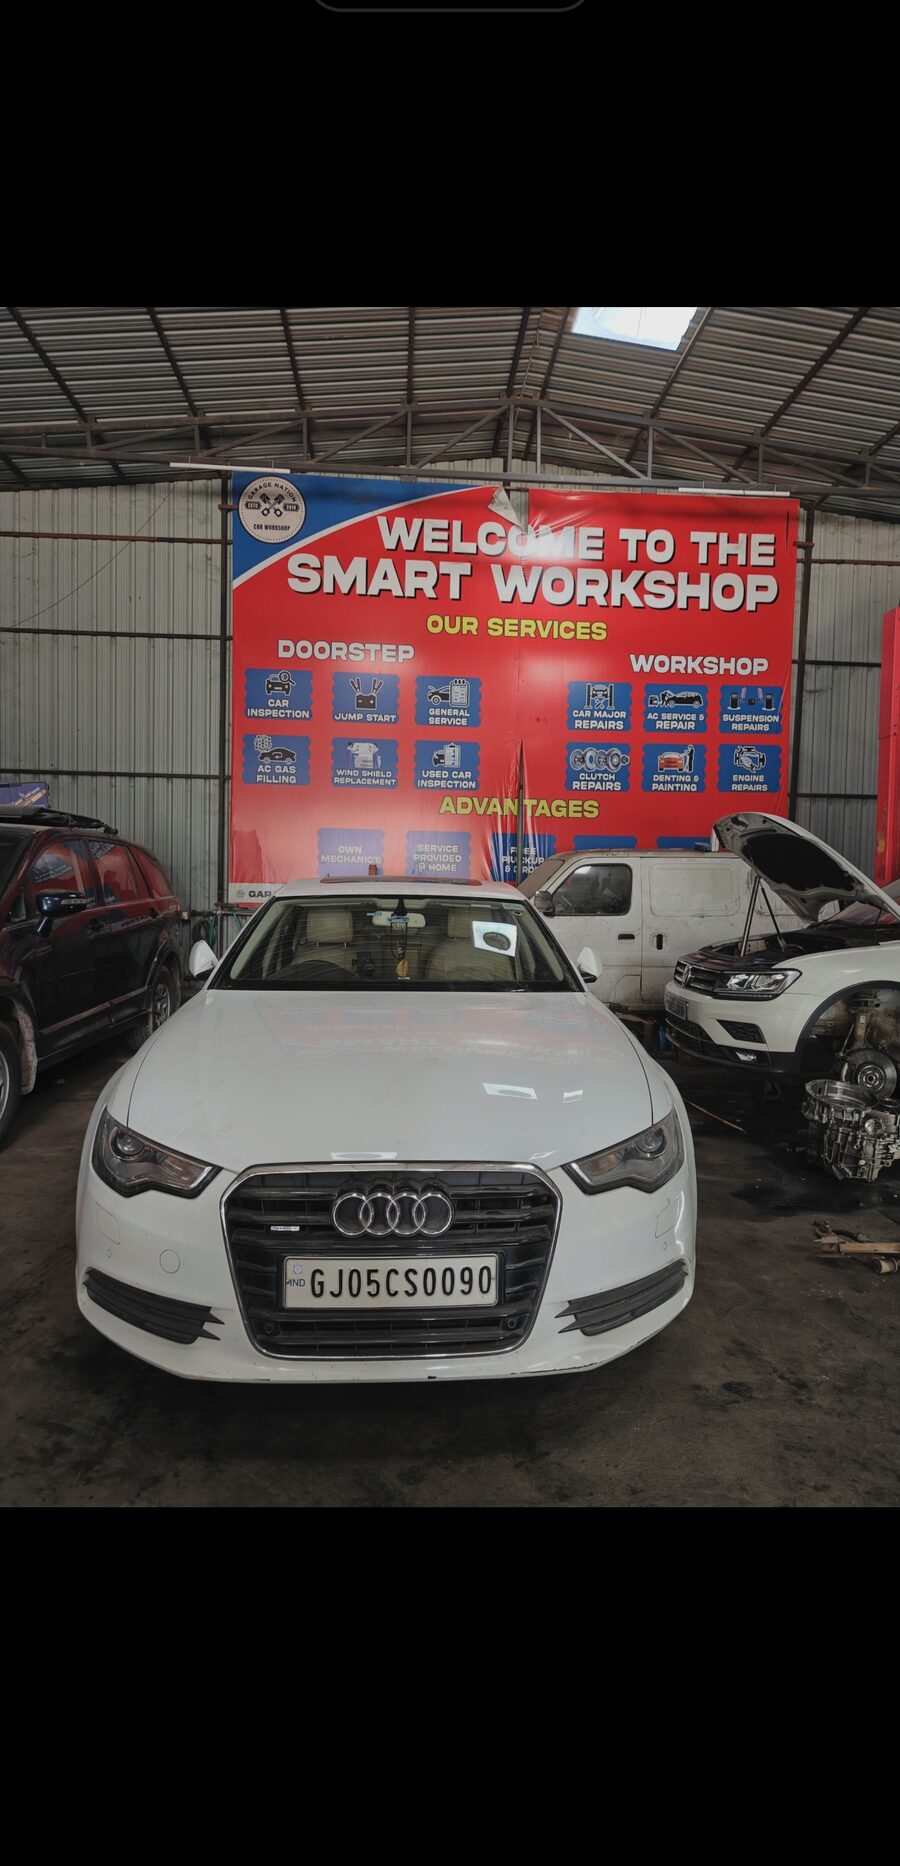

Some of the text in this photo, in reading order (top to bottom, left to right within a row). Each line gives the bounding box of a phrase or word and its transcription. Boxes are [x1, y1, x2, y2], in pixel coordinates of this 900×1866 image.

[248, 482, 297, 502] GARAGE NATION
[377, 515, 776, 567] WELCOME TO THE
[287, 553, 778, 612] SMART WORKSHOP
[426, 614, 606, 640] OUR SERVICES
[277, 640, 415, 663] DOORSTEP
[629, 654, 769, 676] WORKSHOP
[268, 698, 289, 708] CAR
[247, 708, 310, 719] INSPECTION
[428, 708, 470, 717] GENERAL
[572, 710, 626, 719] CAR MAJOR
[662, 713, 696, 721] SERVICE
[334, 713, 396, 723] JUMP START
[428, 717, 468, 726] SERVICE
[722, 714, 779, 723] SUSPENSION
[574, 720, 624, 730] REPAIRS
[656, 720, 695, 730] REPAIR
[732, 723, 770, 732] REPAIRS
[257, 764, 296, 774] AC GAS
[362, 770, 392, 778] SHIELD
[422, 770, 472, 779] USED CAR
[653, 774, 692, 782] DENTING
[733, 774, 764, 782] ENGINE
[256, 774, 297, 784] FILLING
[334, 777, 396, 786] REPLACEMENT
[417, 780, 476, 789] INSPECTION
[572, 781, 621, 791] REPAIRS
[652, 783, 697, 792] PAINTING
[732, 783, 768, 792] REPAIRS
[440, 796, 600, 818] ADVANTAGES
[417, 844, 459, 853] SERVICE
[510, 846, 536, 855] FEE
[321, 854, 383, 864] MECHANIC'S
[413, 854, 462, 863] PROVIDED
[418, 864, 457, 872] @ HOME
[514, 866, 538, 874] RO
[249, 890, 273, 898] GAR
[290, 1265, 493, 1298] IND GJ05CS0090
